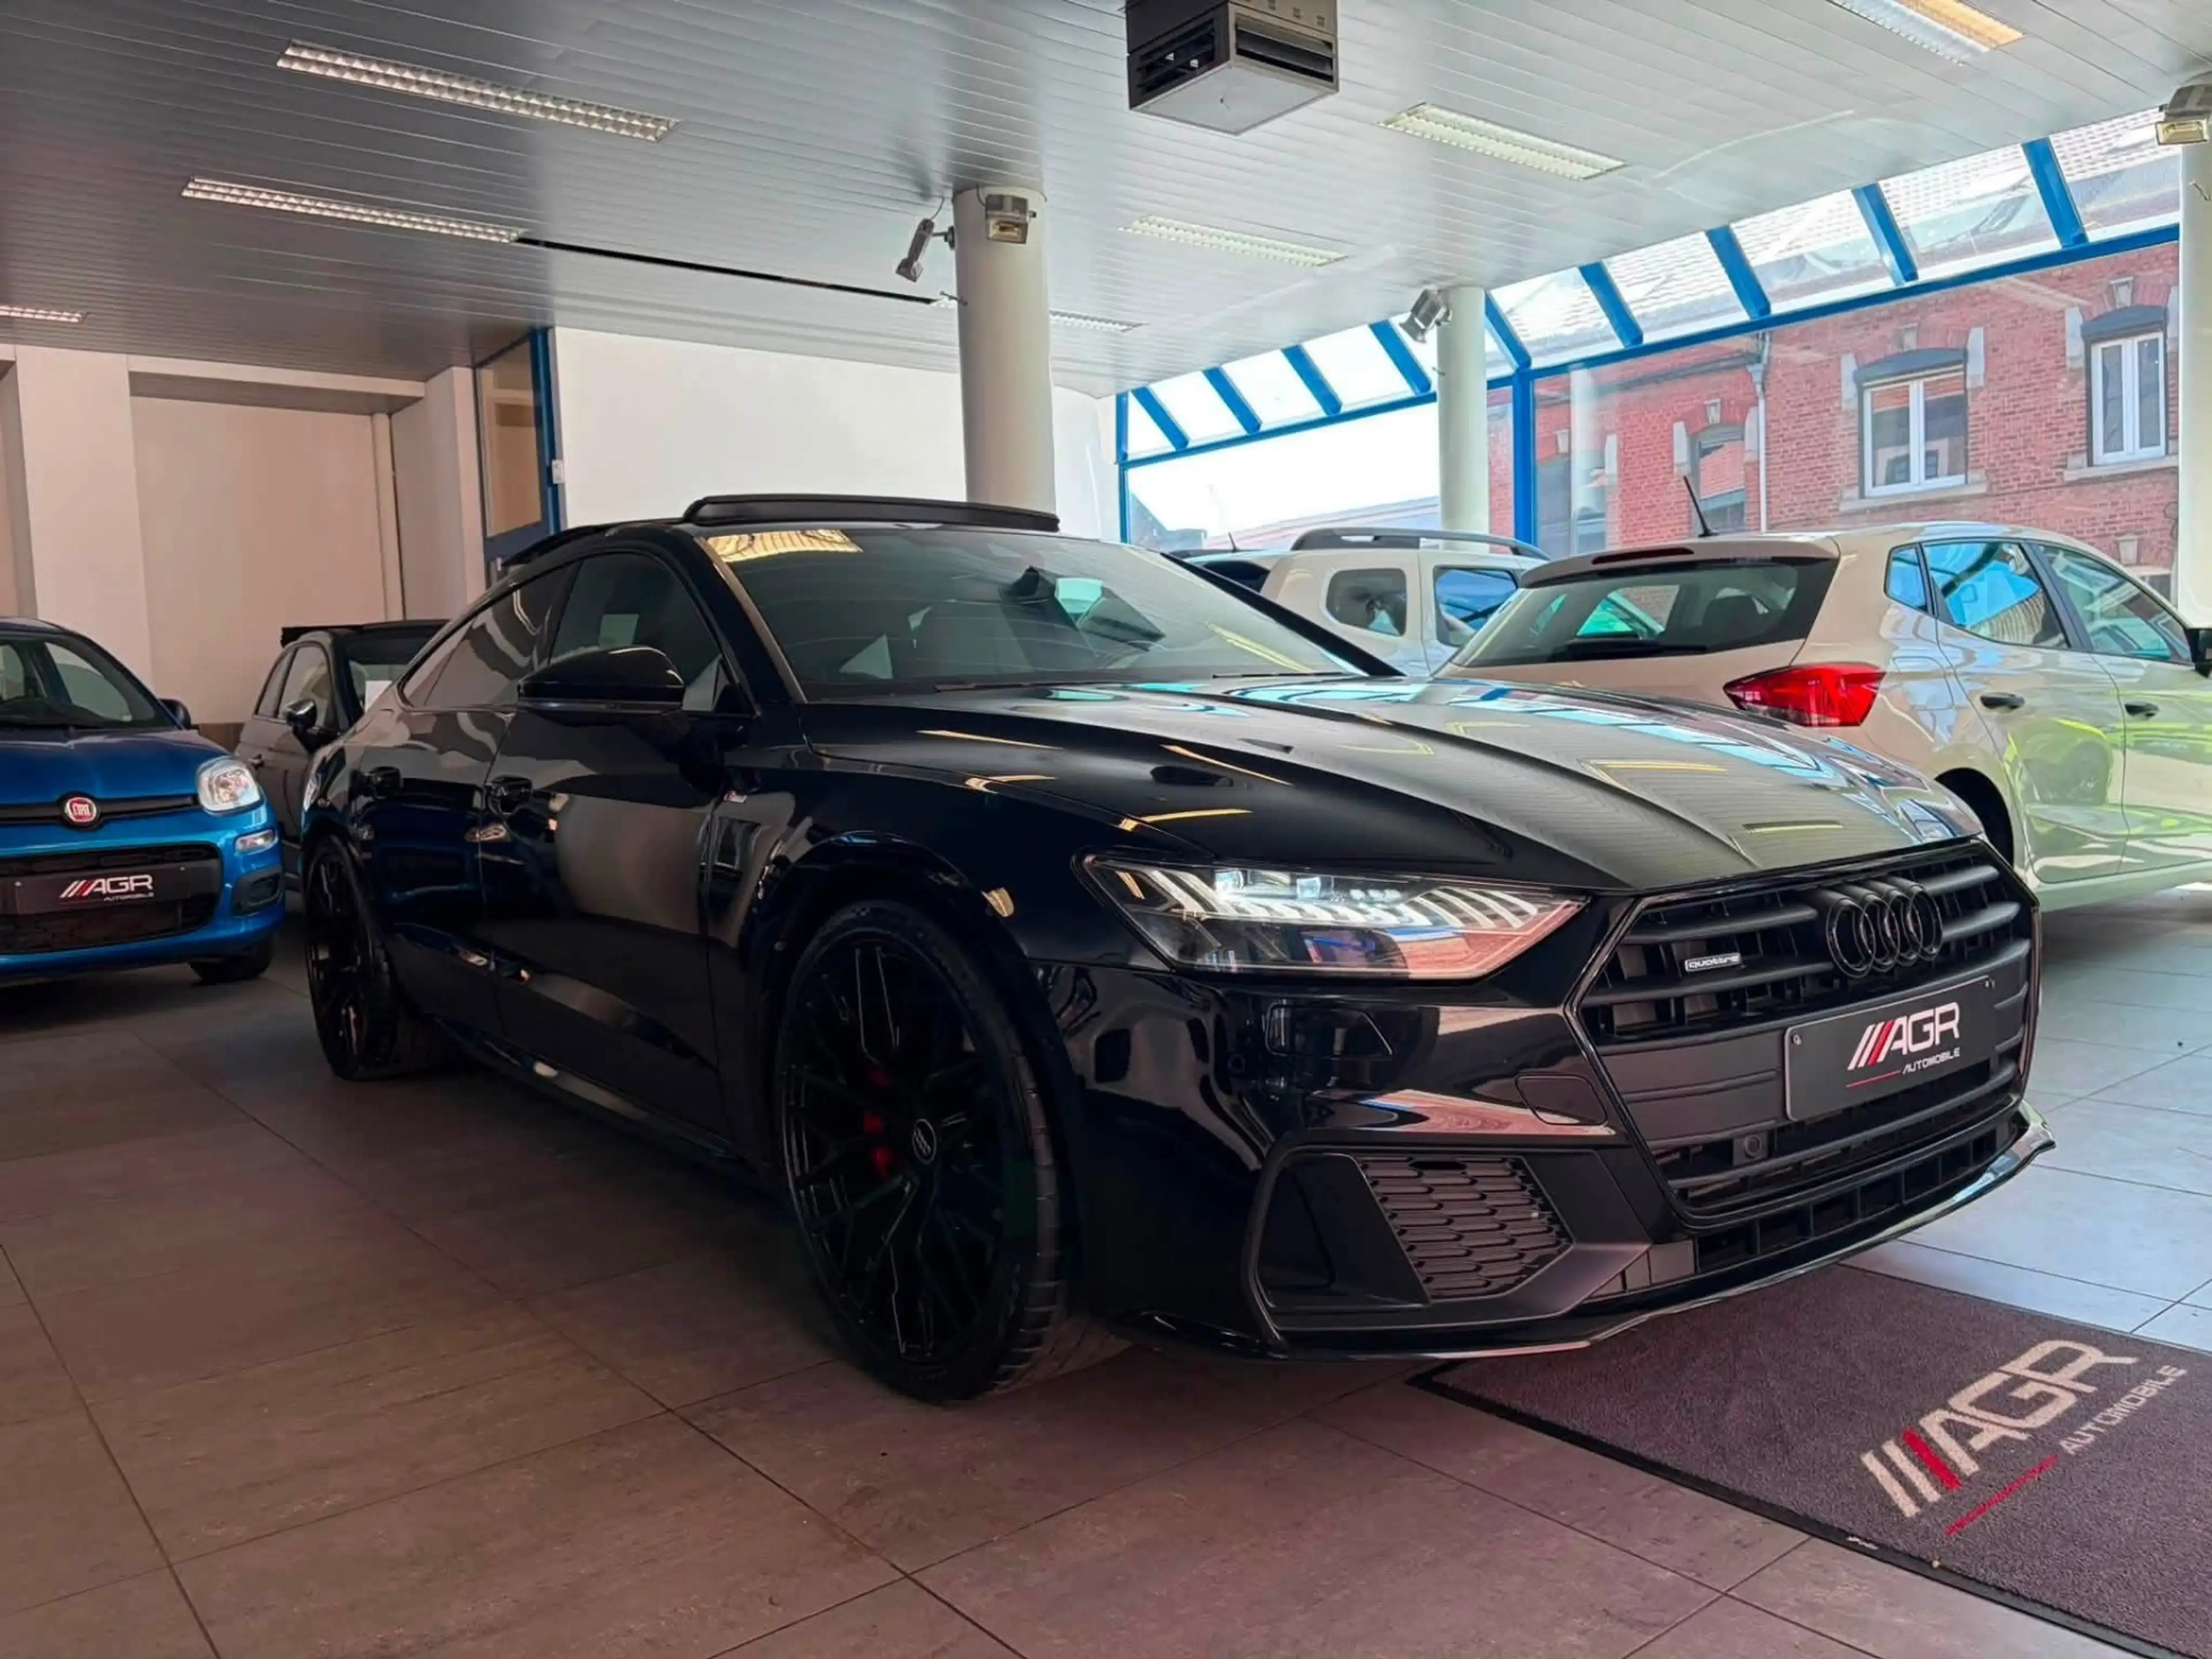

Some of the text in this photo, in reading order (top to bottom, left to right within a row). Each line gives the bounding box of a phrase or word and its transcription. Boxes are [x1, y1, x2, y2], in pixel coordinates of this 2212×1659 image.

[82, 874, 153, 897] AGR
[1877, 1002, 1960, 1062] AGR
[1902, 1047, 1960, 1075] AUTOMOBILE
[1919, 1339, 2139, 1476] AGR
[2059, 1365, 2187, 1455] AUTOMOBILE
